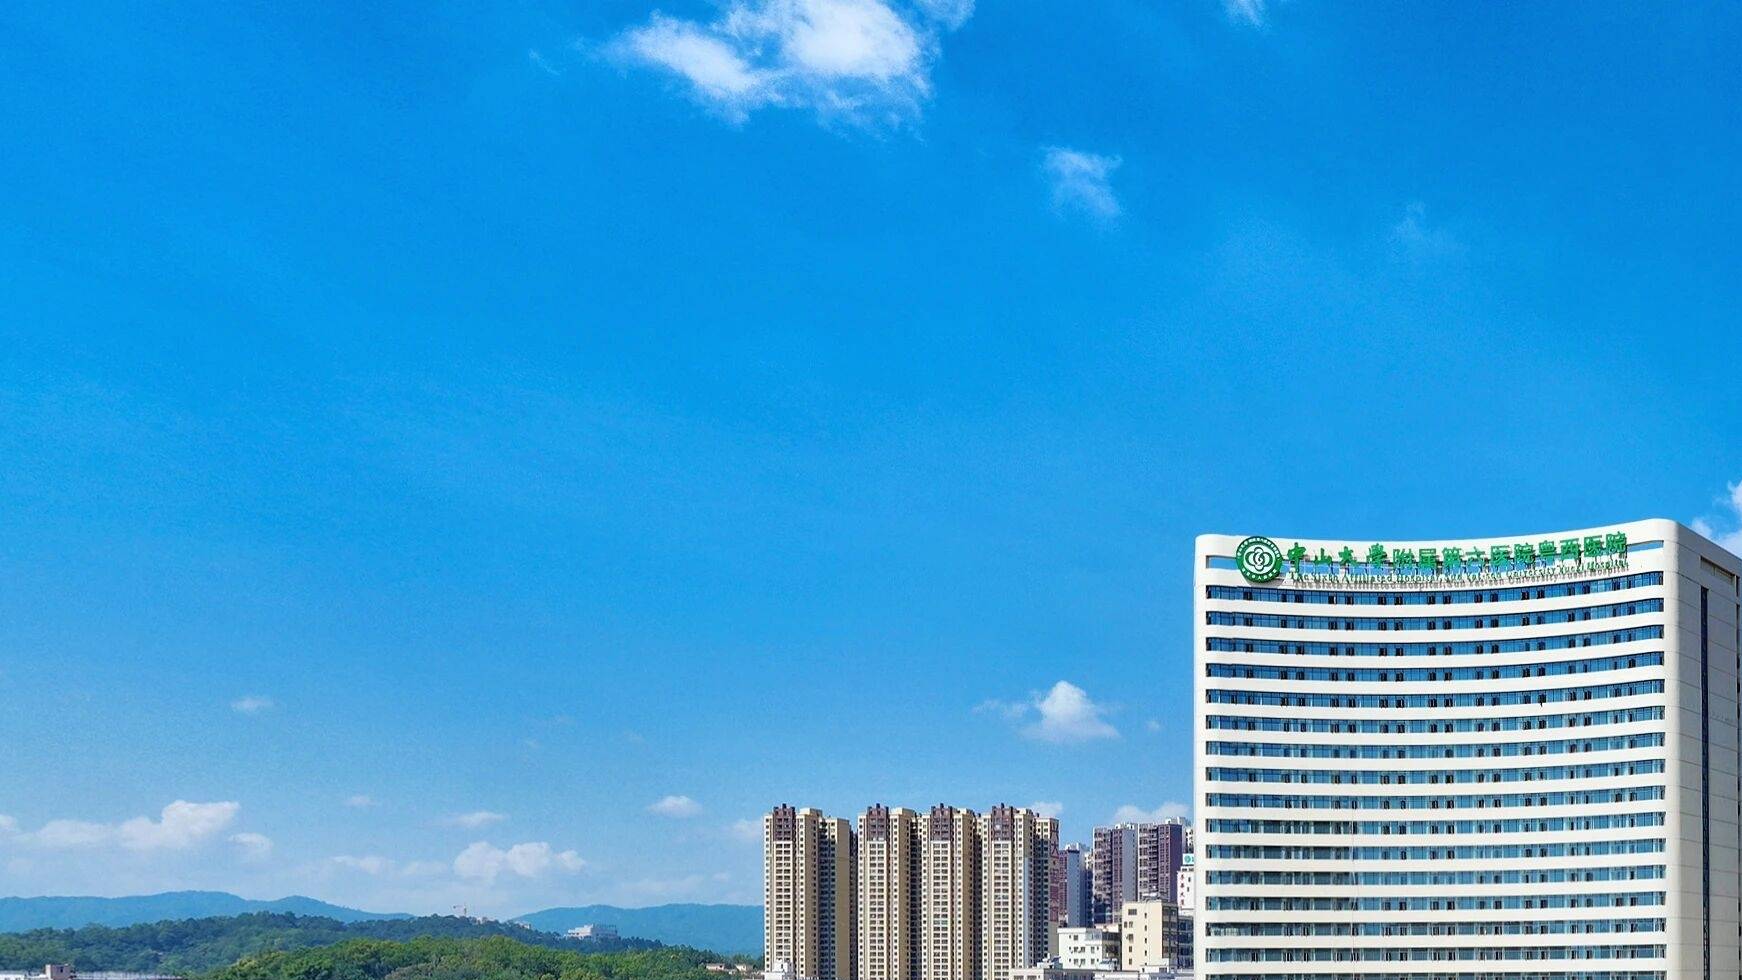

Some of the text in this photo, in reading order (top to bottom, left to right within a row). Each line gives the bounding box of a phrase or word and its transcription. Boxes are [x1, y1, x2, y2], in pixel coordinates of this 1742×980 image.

[1287, 531, 1627, 573] 中山大学附属第六医院粤西医院
